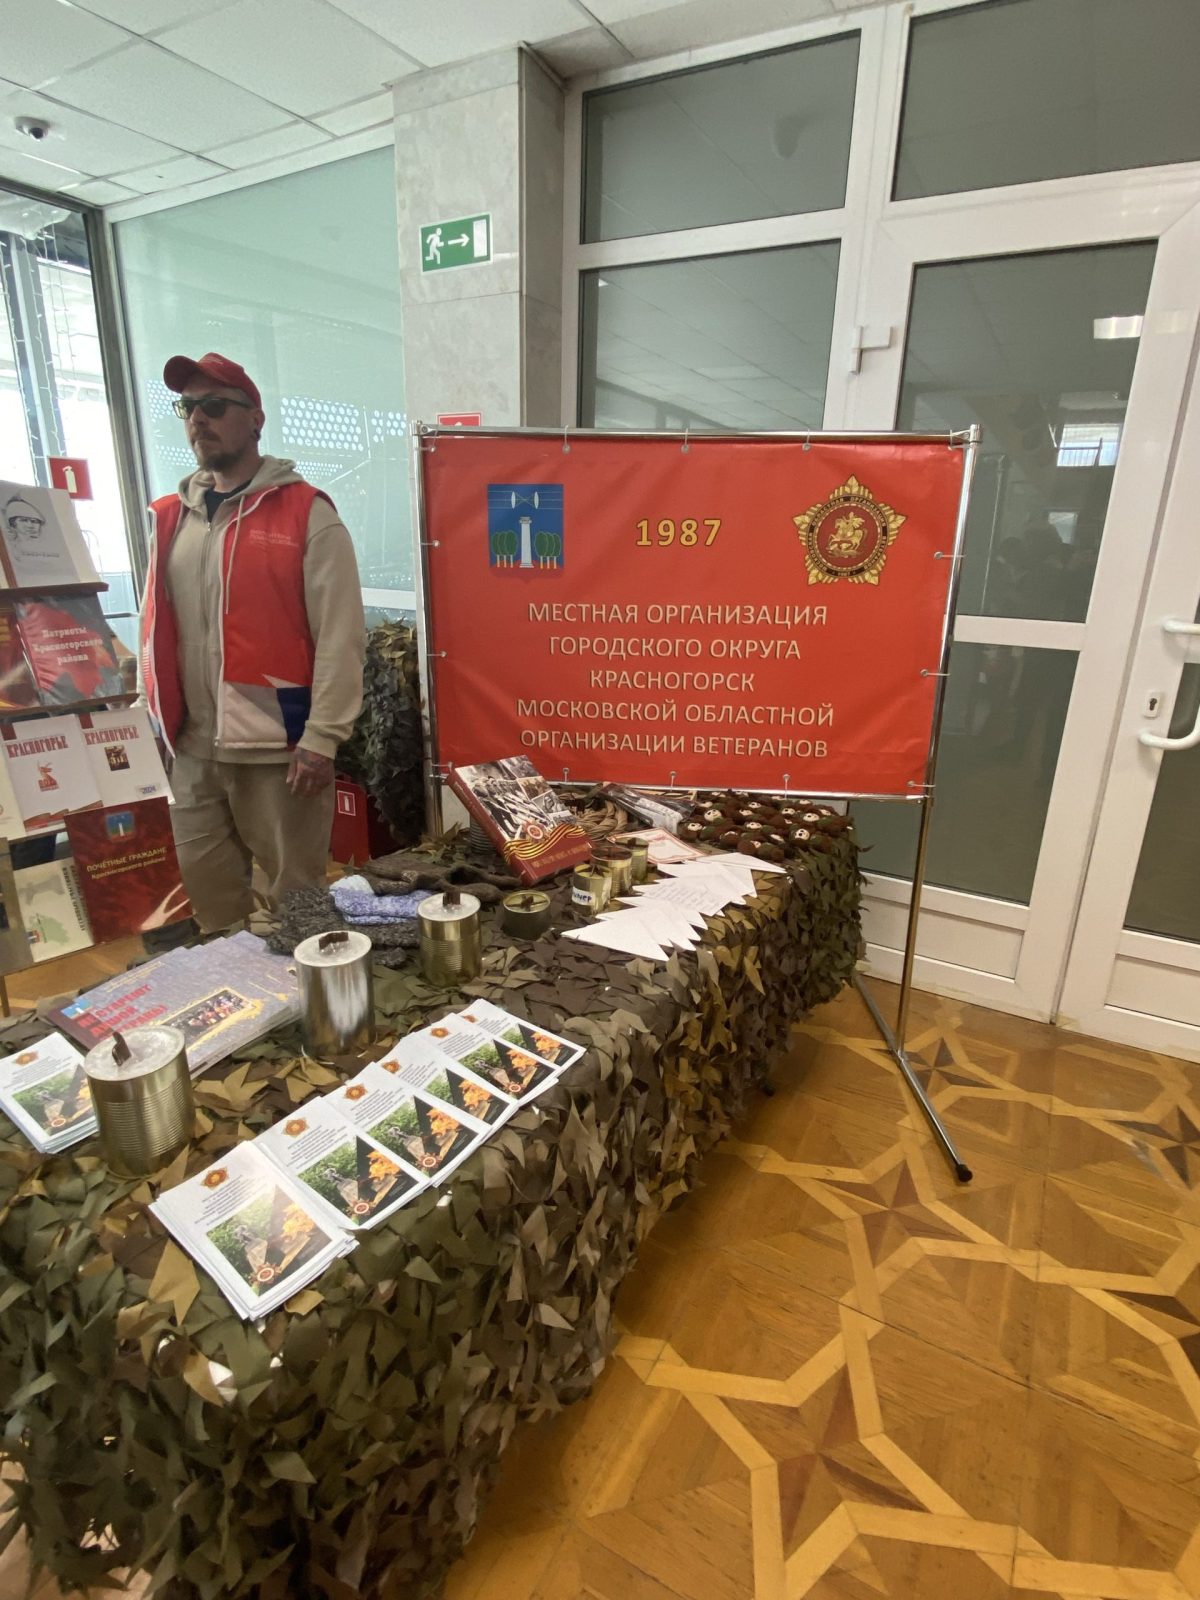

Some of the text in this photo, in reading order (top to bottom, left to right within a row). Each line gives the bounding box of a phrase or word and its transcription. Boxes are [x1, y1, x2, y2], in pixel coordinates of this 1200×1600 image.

[636, 518, 722, 547] 1987
[528, 602, 828, 630] МЕСТНАЯ ОРГАНИЗАЦИЯ
[41, 626, 87, 638] Патриоты
[32, 638, 103, 653] Красногорского
[550, 636, 801, 660] ГОРОДСКОГО ОКРУГА
[590, 670, 755, 692] КРАСНОГОРСК
[517, 698, 834, 727] МОСКОВСКОЙ ОБЛАСТНОЙ
[7, 735, 69, 758] КРАСНОГОРЬЕ
[84, 726, 140, 746] КРАСНОГОРЬЕ
[520, 730, 828, 758] ОРГАНИЗАЦИИ ВЕТЕРАНОВ
[128, 846, 167, 861] ГРАЖДАНЕ
